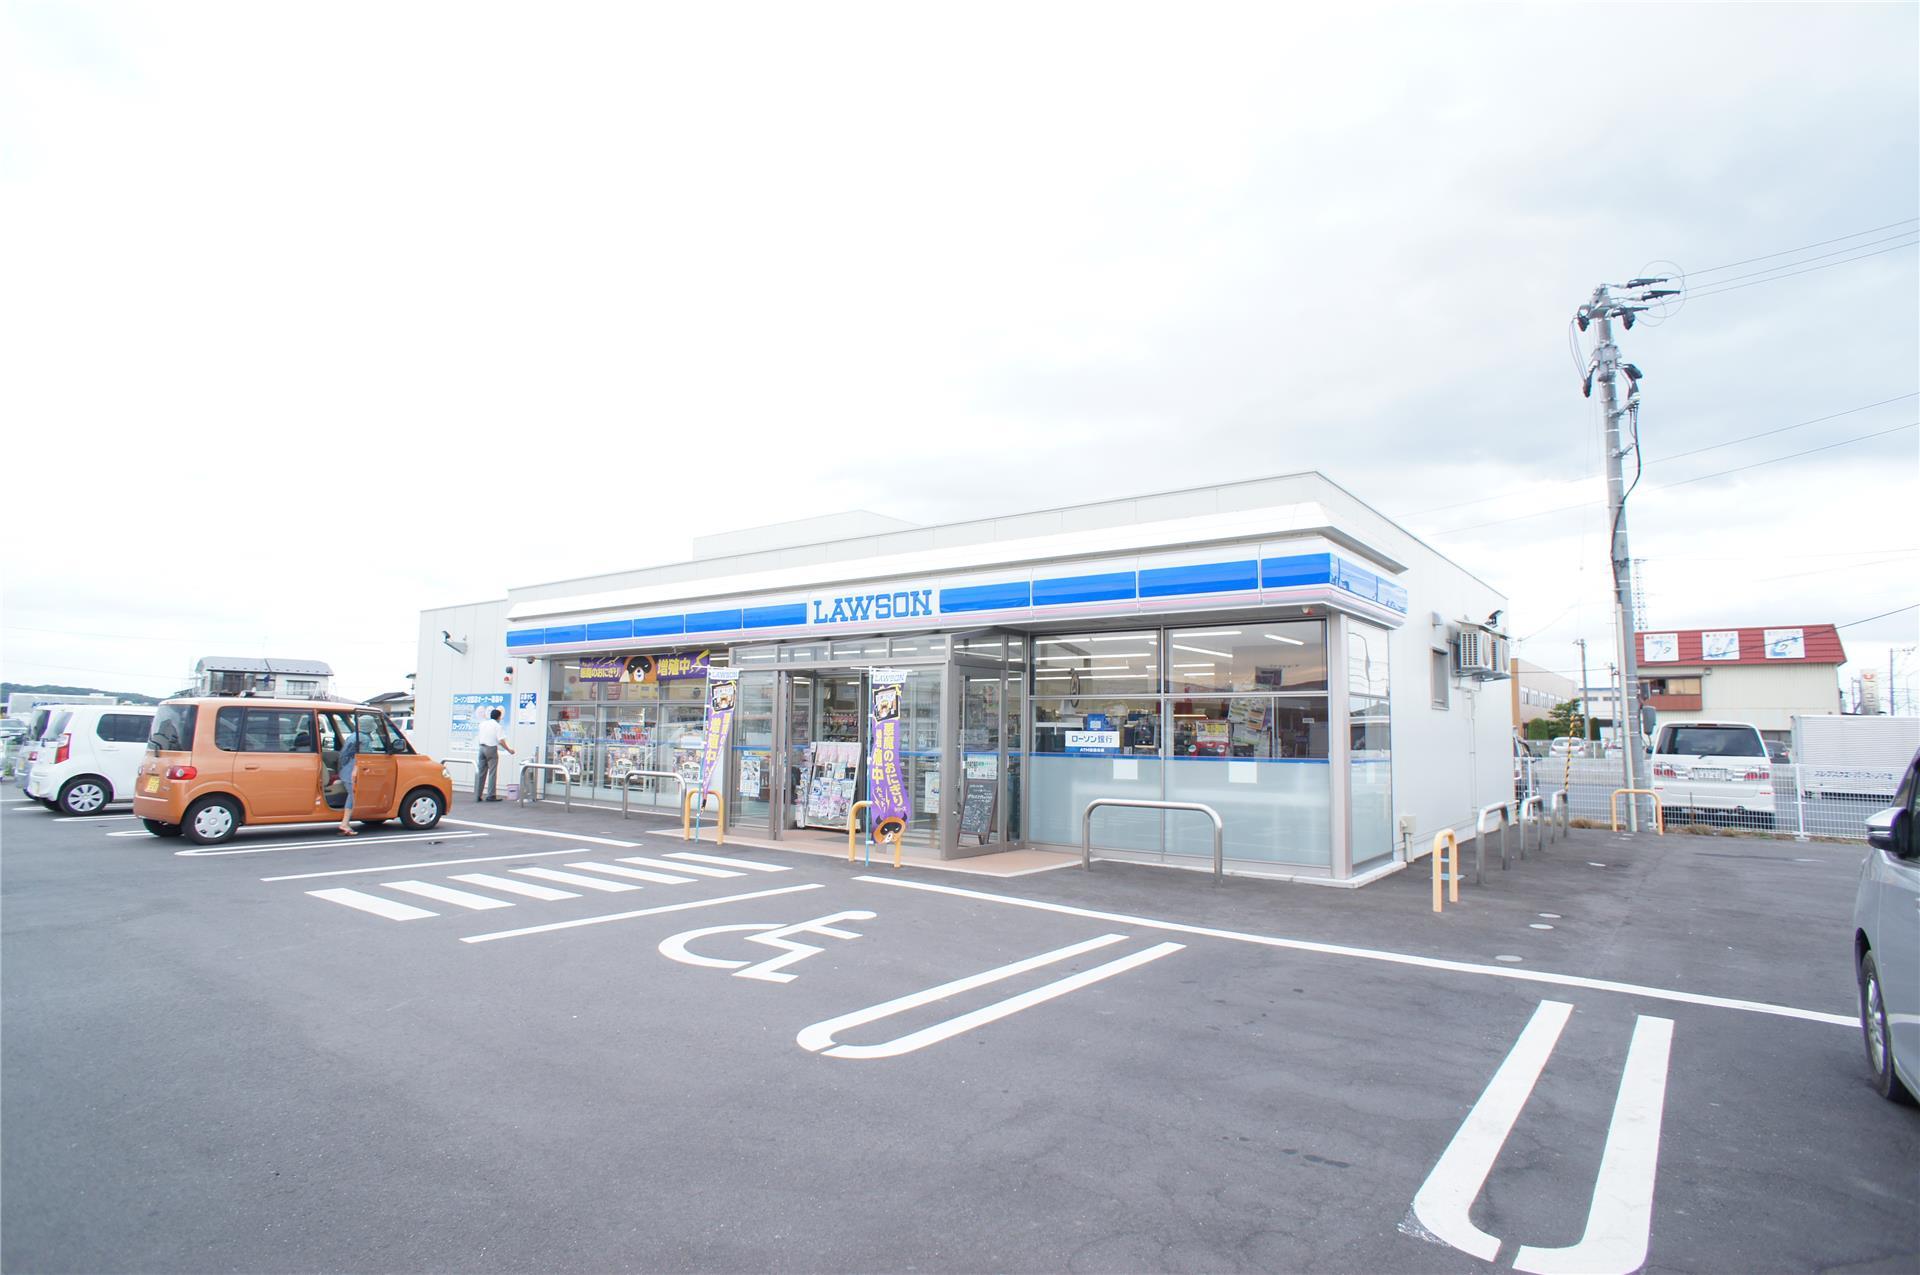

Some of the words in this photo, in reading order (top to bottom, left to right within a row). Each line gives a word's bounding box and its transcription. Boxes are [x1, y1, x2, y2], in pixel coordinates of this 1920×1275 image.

[814, 589, 932, 624] LAWSON
[1071, 734, 1113, 744] ローソン銀行
